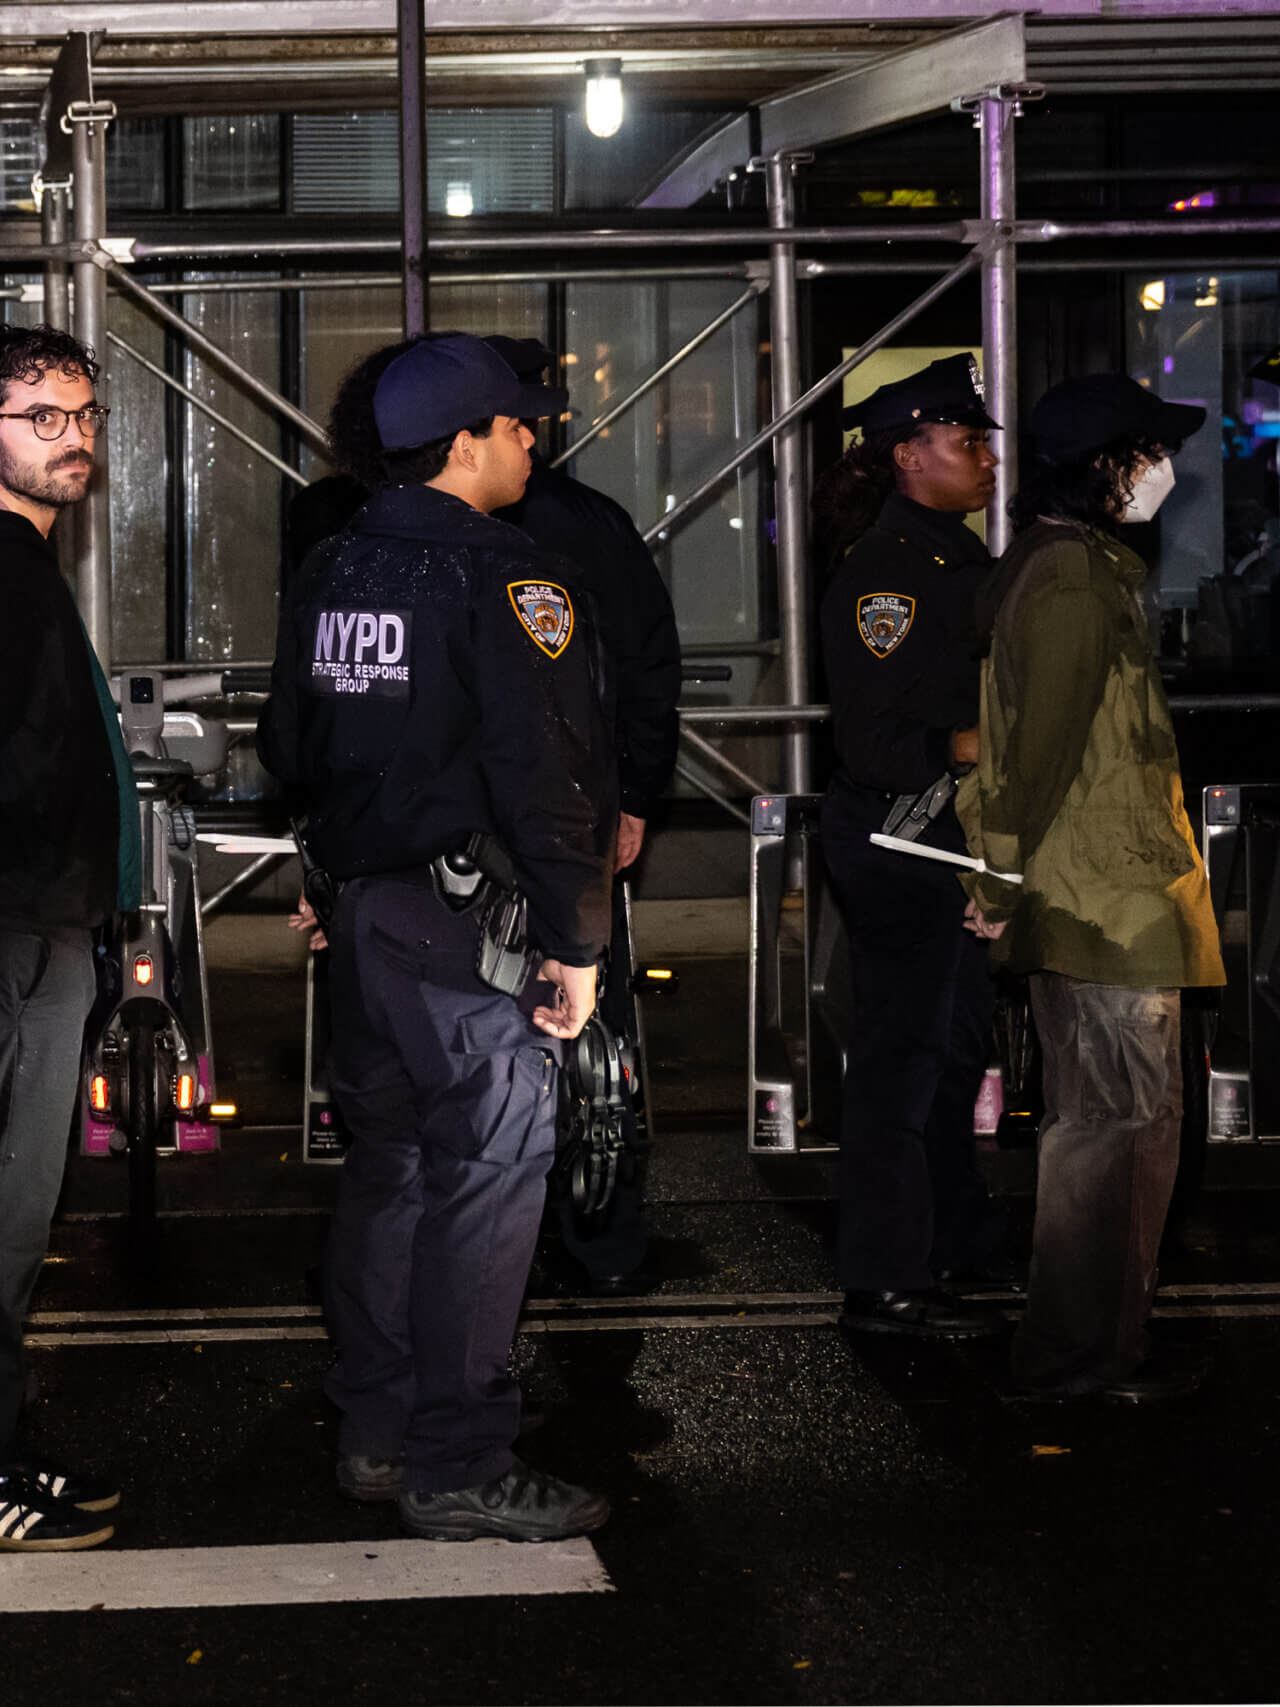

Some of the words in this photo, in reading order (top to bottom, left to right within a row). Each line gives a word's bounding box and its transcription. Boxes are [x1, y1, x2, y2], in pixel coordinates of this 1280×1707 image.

[523, 586, 553, 595] POLICE
[872, 597, 900, 605] POLICE
[315, 612, 405, 664] NYPD
[354, 664, 409, 681] RESPONSE
[335, 678, 370, 693] GROUP
